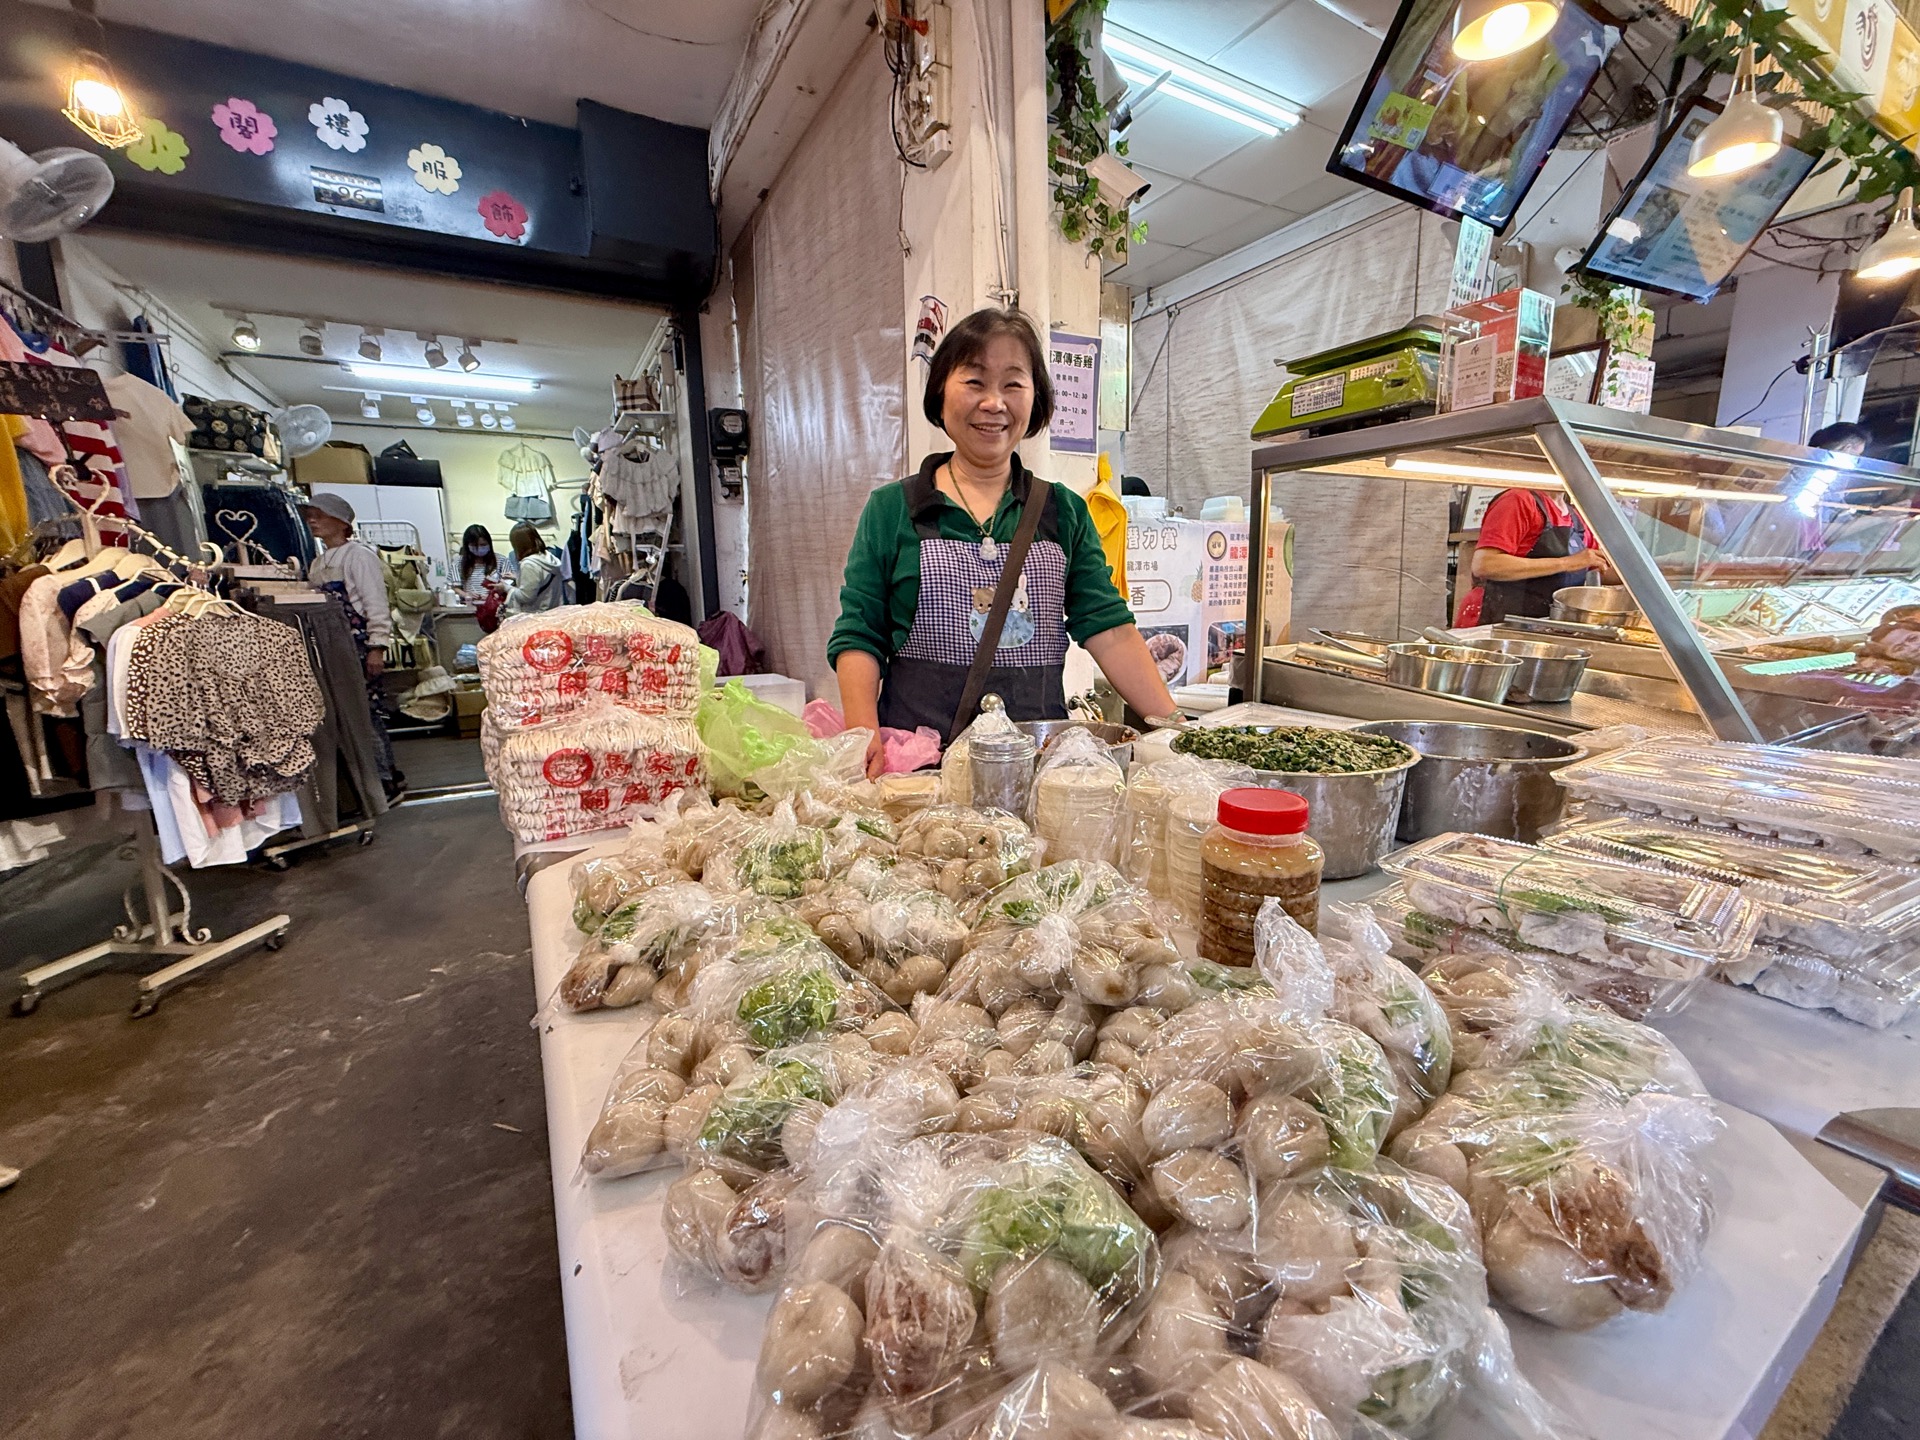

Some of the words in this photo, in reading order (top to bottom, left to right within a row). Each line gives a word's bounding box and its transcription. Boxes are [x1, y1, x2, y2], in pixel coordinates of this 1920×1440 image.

[1050, 350, 1093, 369] 潭傳香雞
[1127, 561, 1158, 571] 龍潭市場
[603, 749, 675, 780] 馬家
